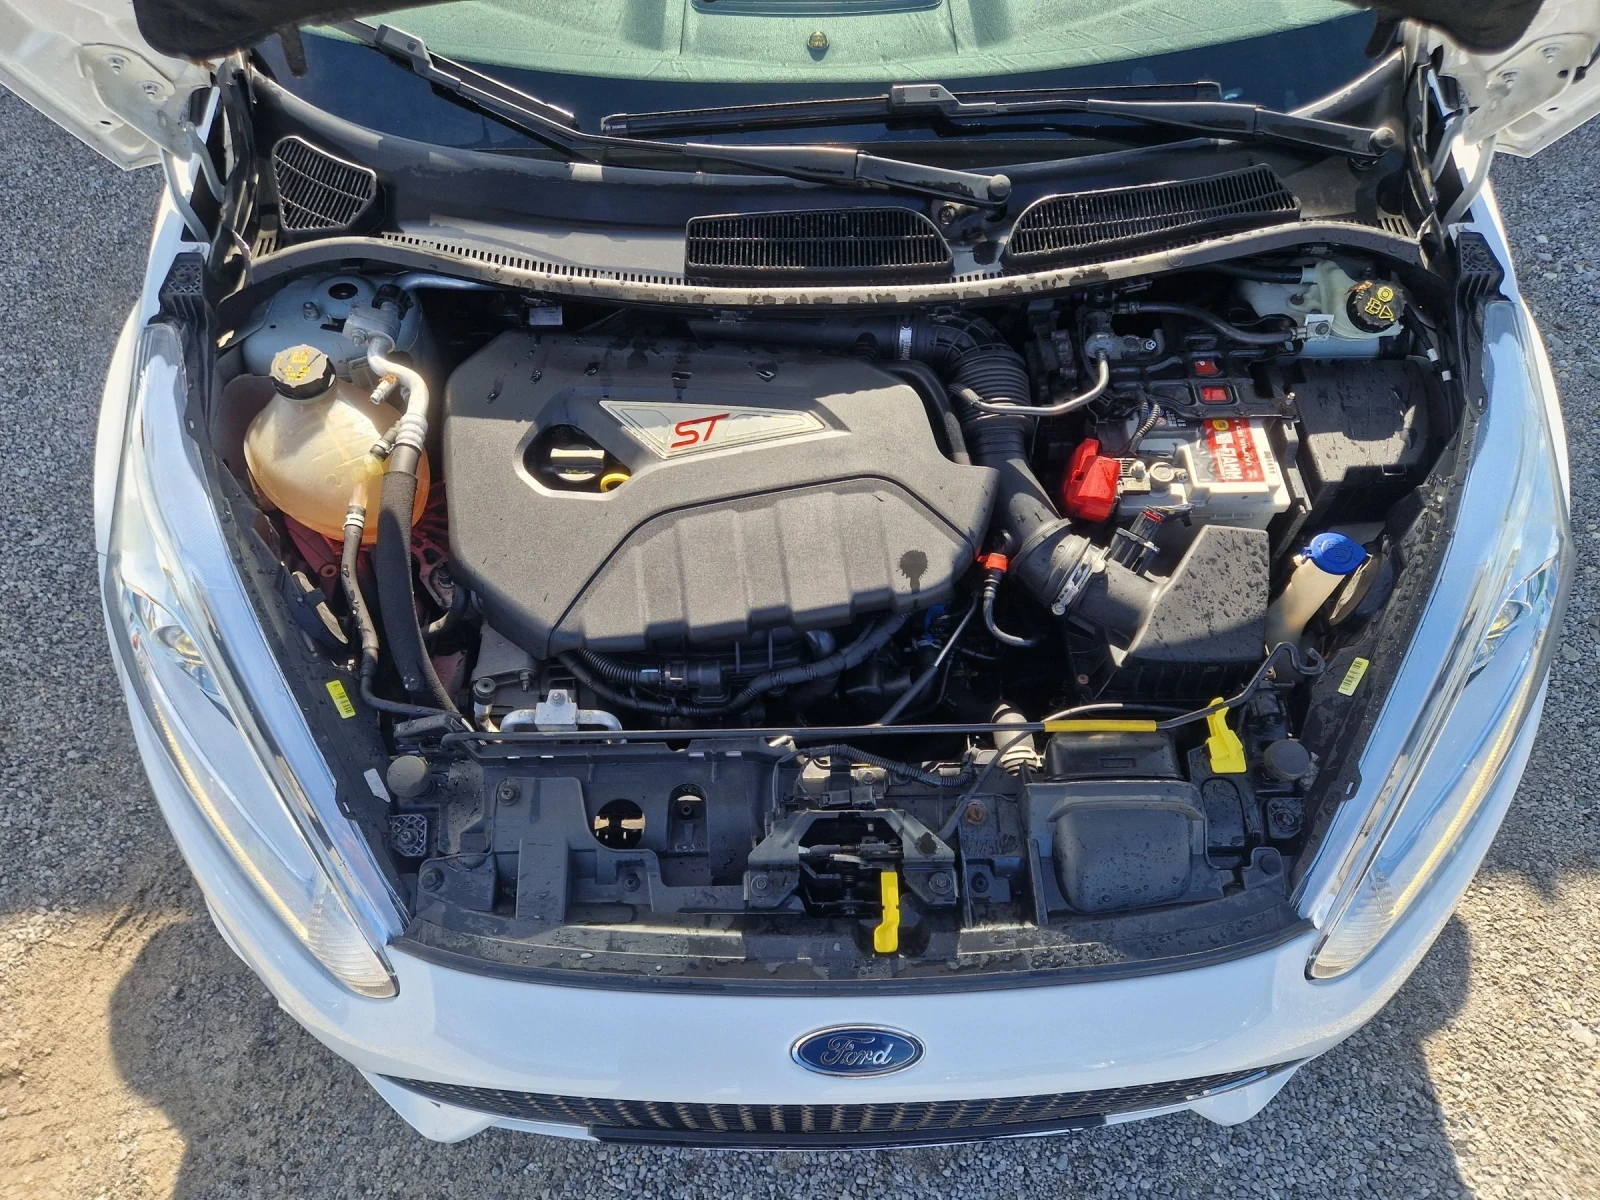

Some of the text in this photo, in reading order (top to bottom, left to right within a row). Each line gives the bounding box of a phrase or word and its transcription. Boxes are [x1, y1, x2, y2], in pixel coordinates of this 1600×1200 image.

[671, 413, 730, 448] ST
[1221, 447, 1244, 480] FIAMM
[820, 1035, 894, 1066] Ford
